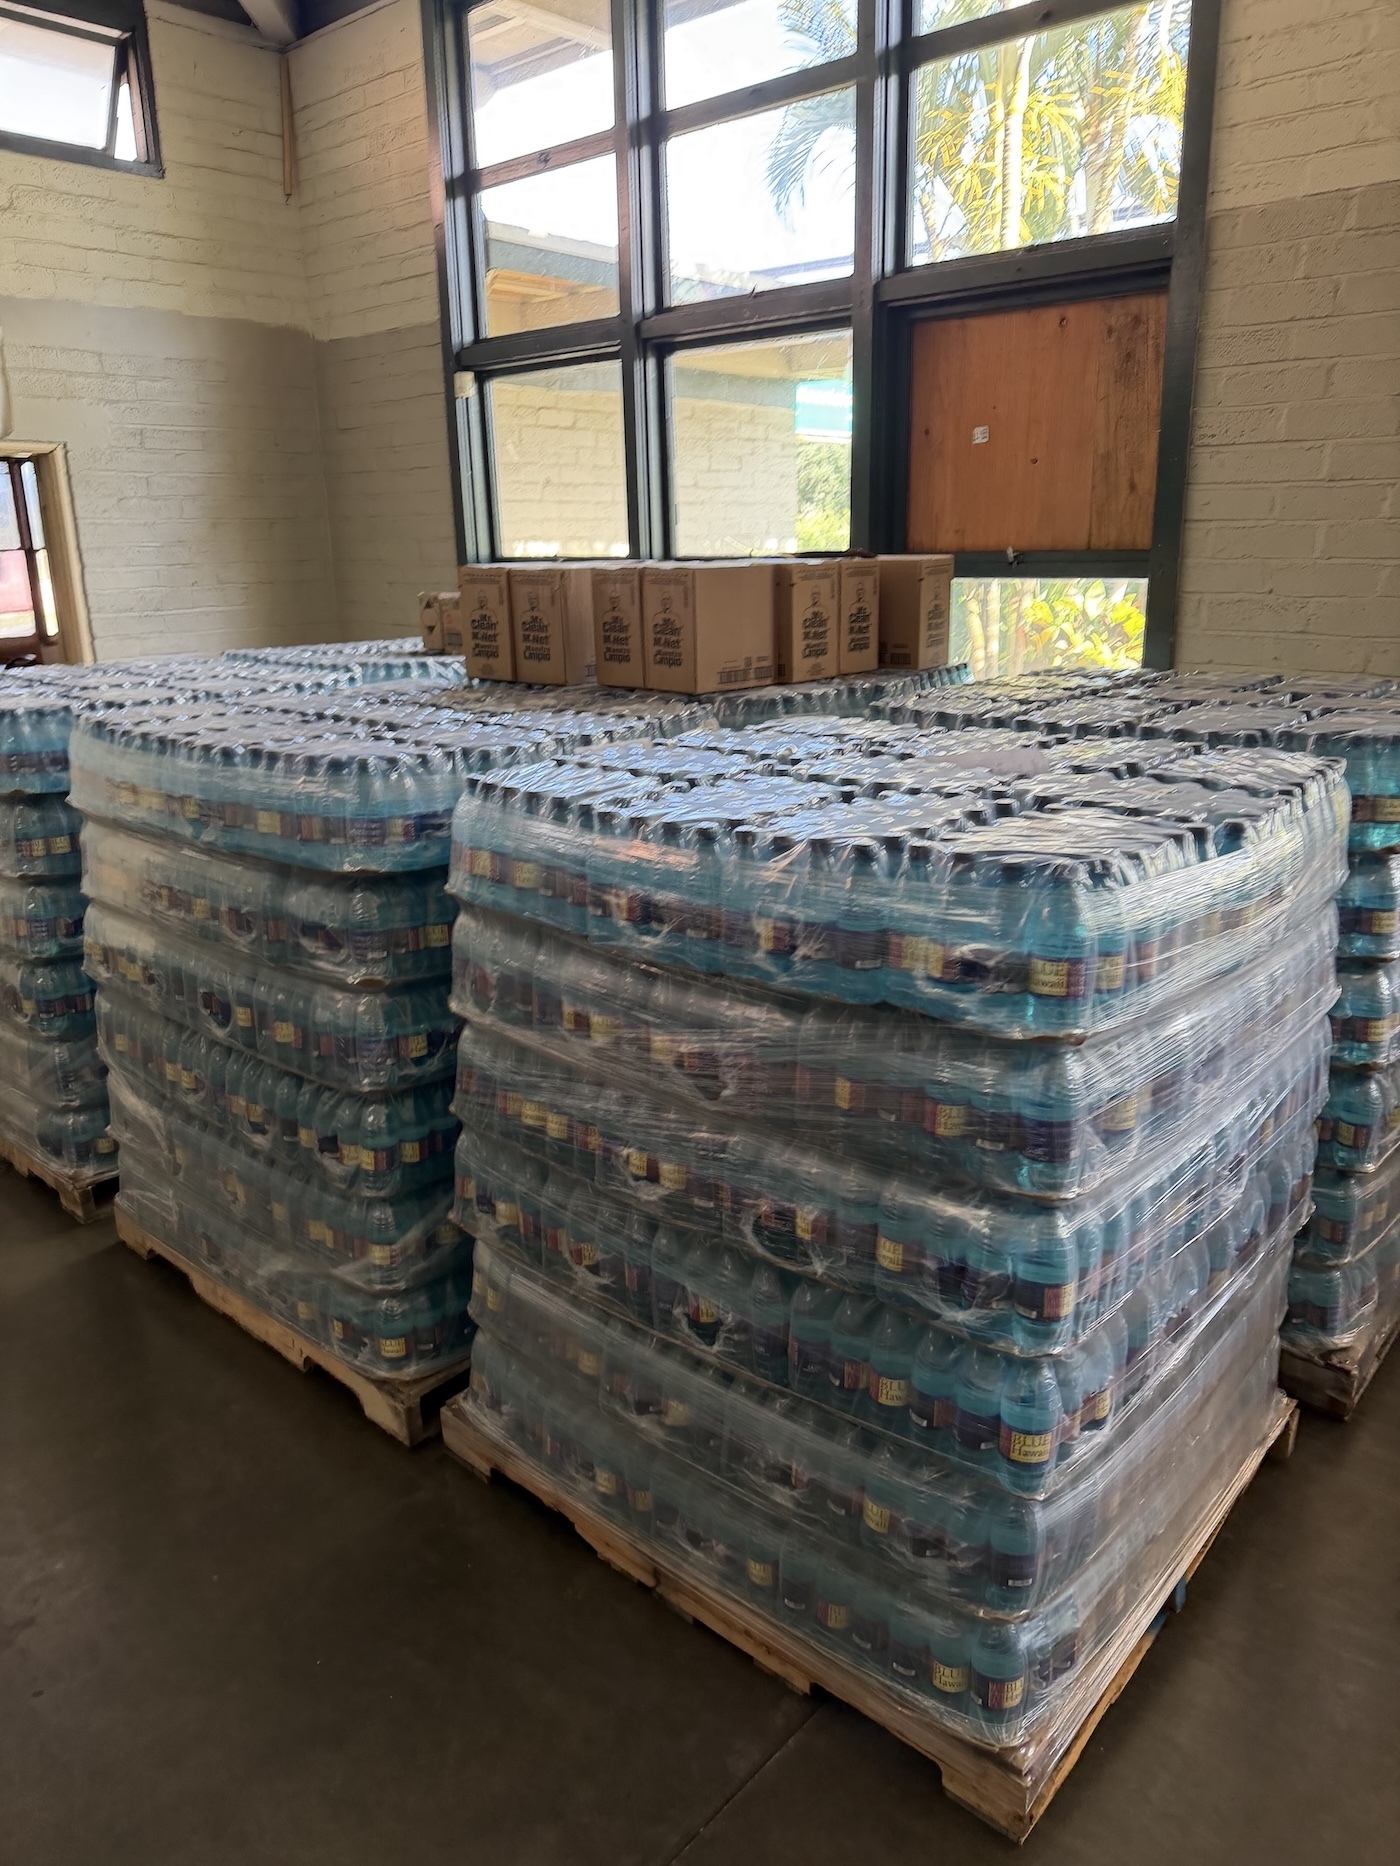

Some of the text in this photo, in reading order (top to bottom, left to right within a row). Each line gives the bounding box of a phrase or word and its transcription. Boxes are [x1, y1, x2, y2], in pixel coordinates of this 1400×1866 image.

[471, 619, 499, 631] Clean
[522, 621, 550, 633] Clean
[603, 621, 631, 634] Clean
[653, 624, 684, 637] Clean
[1013, 1433, 1051, 1448] BLUE
